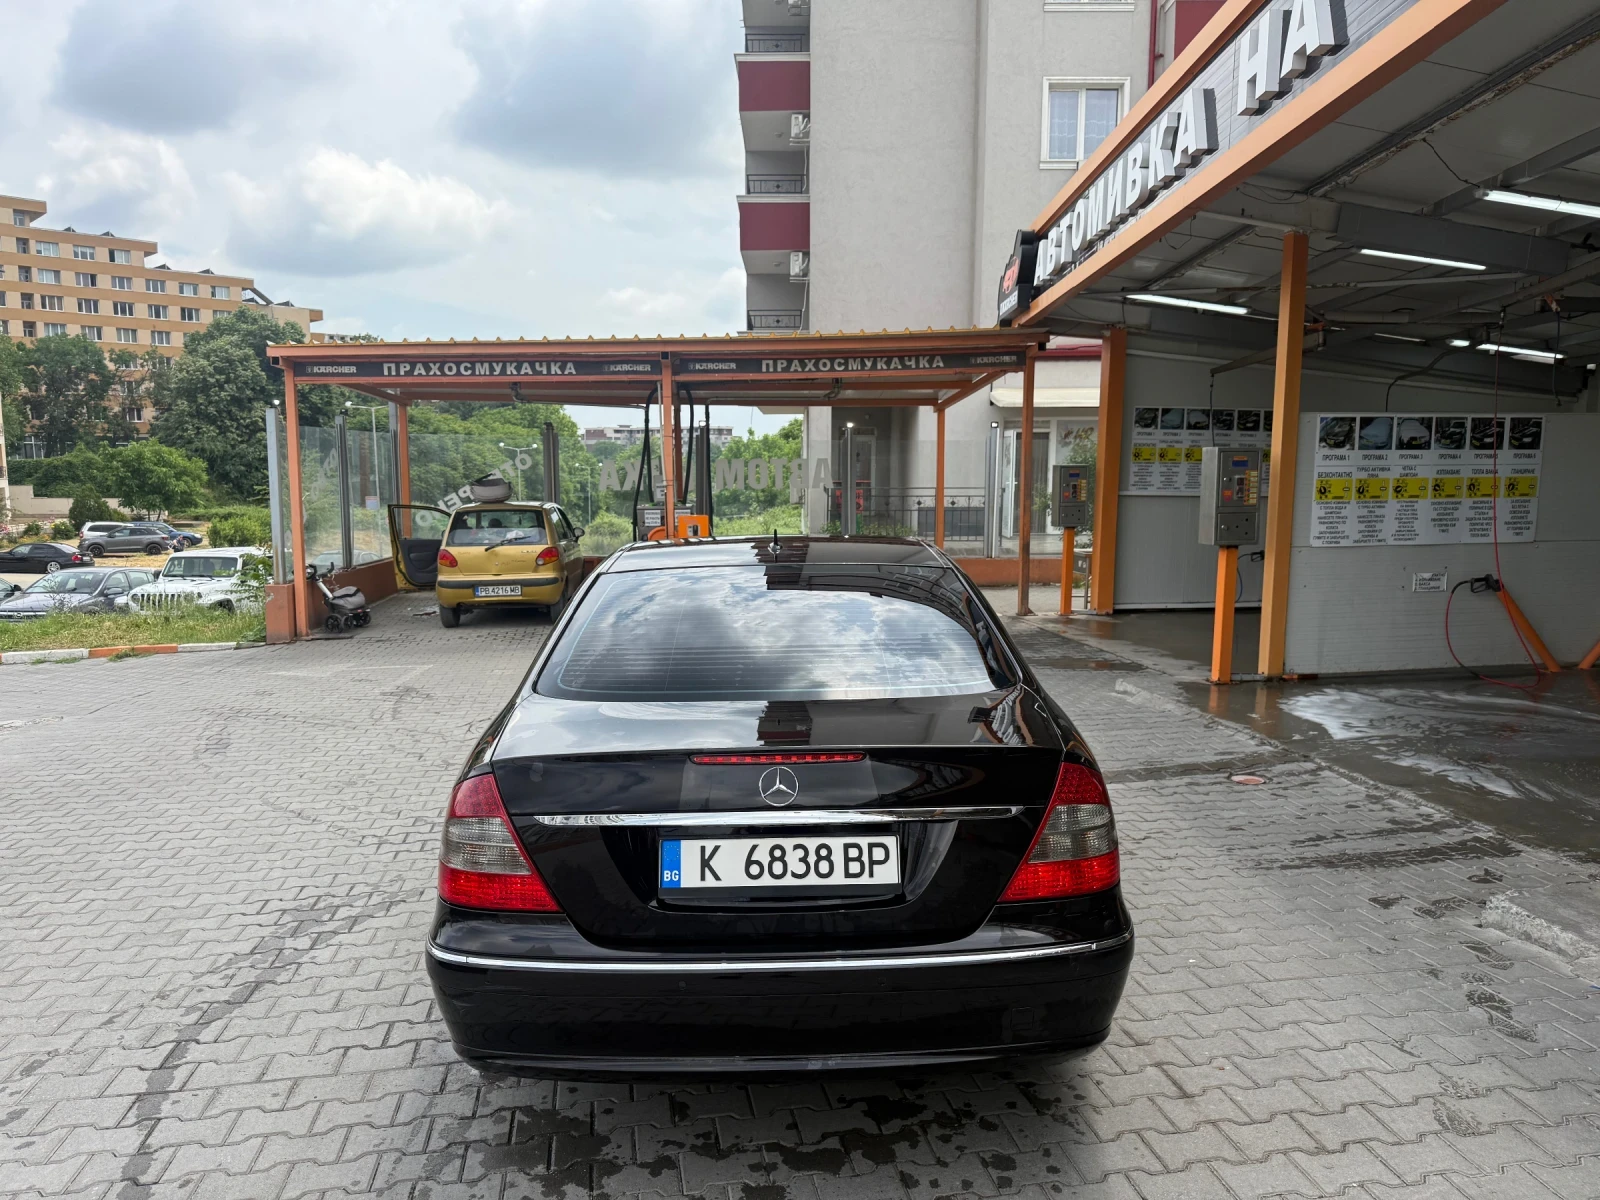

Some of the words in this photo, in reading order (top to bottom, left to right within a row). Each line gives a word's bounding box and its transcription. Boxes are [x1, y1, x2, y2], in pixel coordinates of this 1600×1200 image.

[1033, 88, 1215, 287] АВТОМИВКА
[1237, 0, 1344, 116] НА
[383, 362, 577, 376] ПРАХОСМУКАЧКА
[761, 355, 945, 372] ПРАХОСМУКАЧКА
[490, 586, 508, 594] 4216
[700, 845, 722, 882] K
[744, 843, 835, 880] 6838
[843, 842, 890, 879] BP
[664, 870, 680, 881] BG
